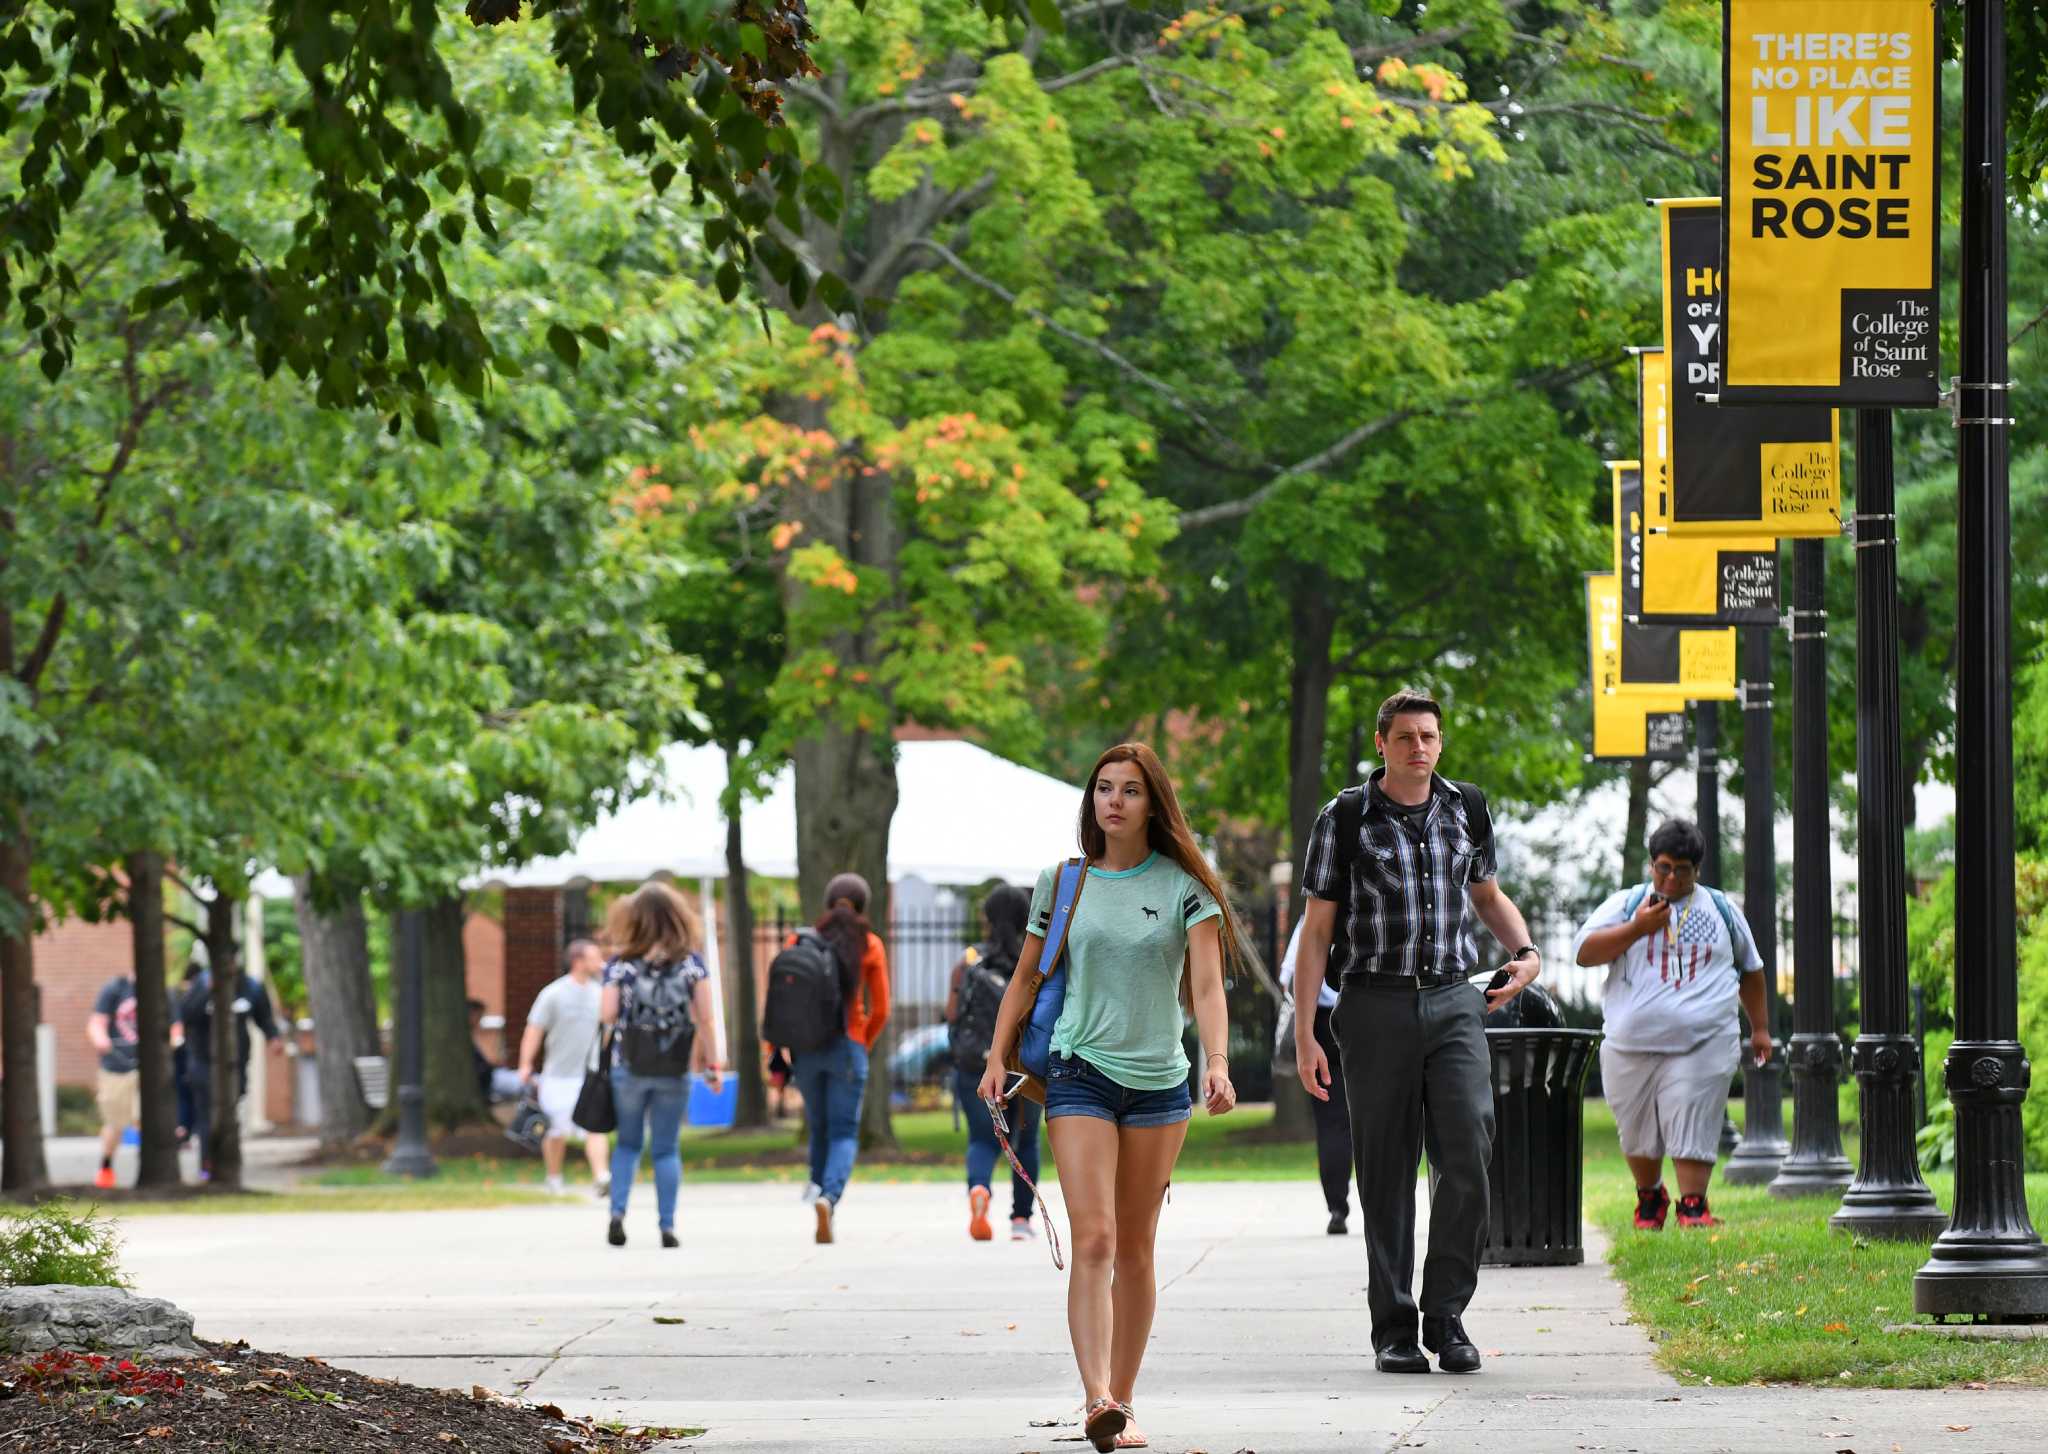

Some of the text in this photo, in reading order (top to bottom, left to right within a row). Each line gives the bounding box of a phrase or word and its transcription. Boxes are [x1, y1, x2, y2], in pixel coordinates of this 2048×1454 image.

[1752, 32, 1911, 61] THERE'S
[1752, 67, 1911, 89] NO PLACE
[1752, 96, 1911, 146] LIKE
[1753, 154, 1910, 190] SAINT
[1752, 198, 1909, 240] ROSE
[1687, 303, 1712, 317] OF
[1897, 300, 1928, 316] The
[1852, 313, 1928, 341] College
[1854, 336, 1928, 360] of Saint
[1852, 356, 1901, 377] Rose
